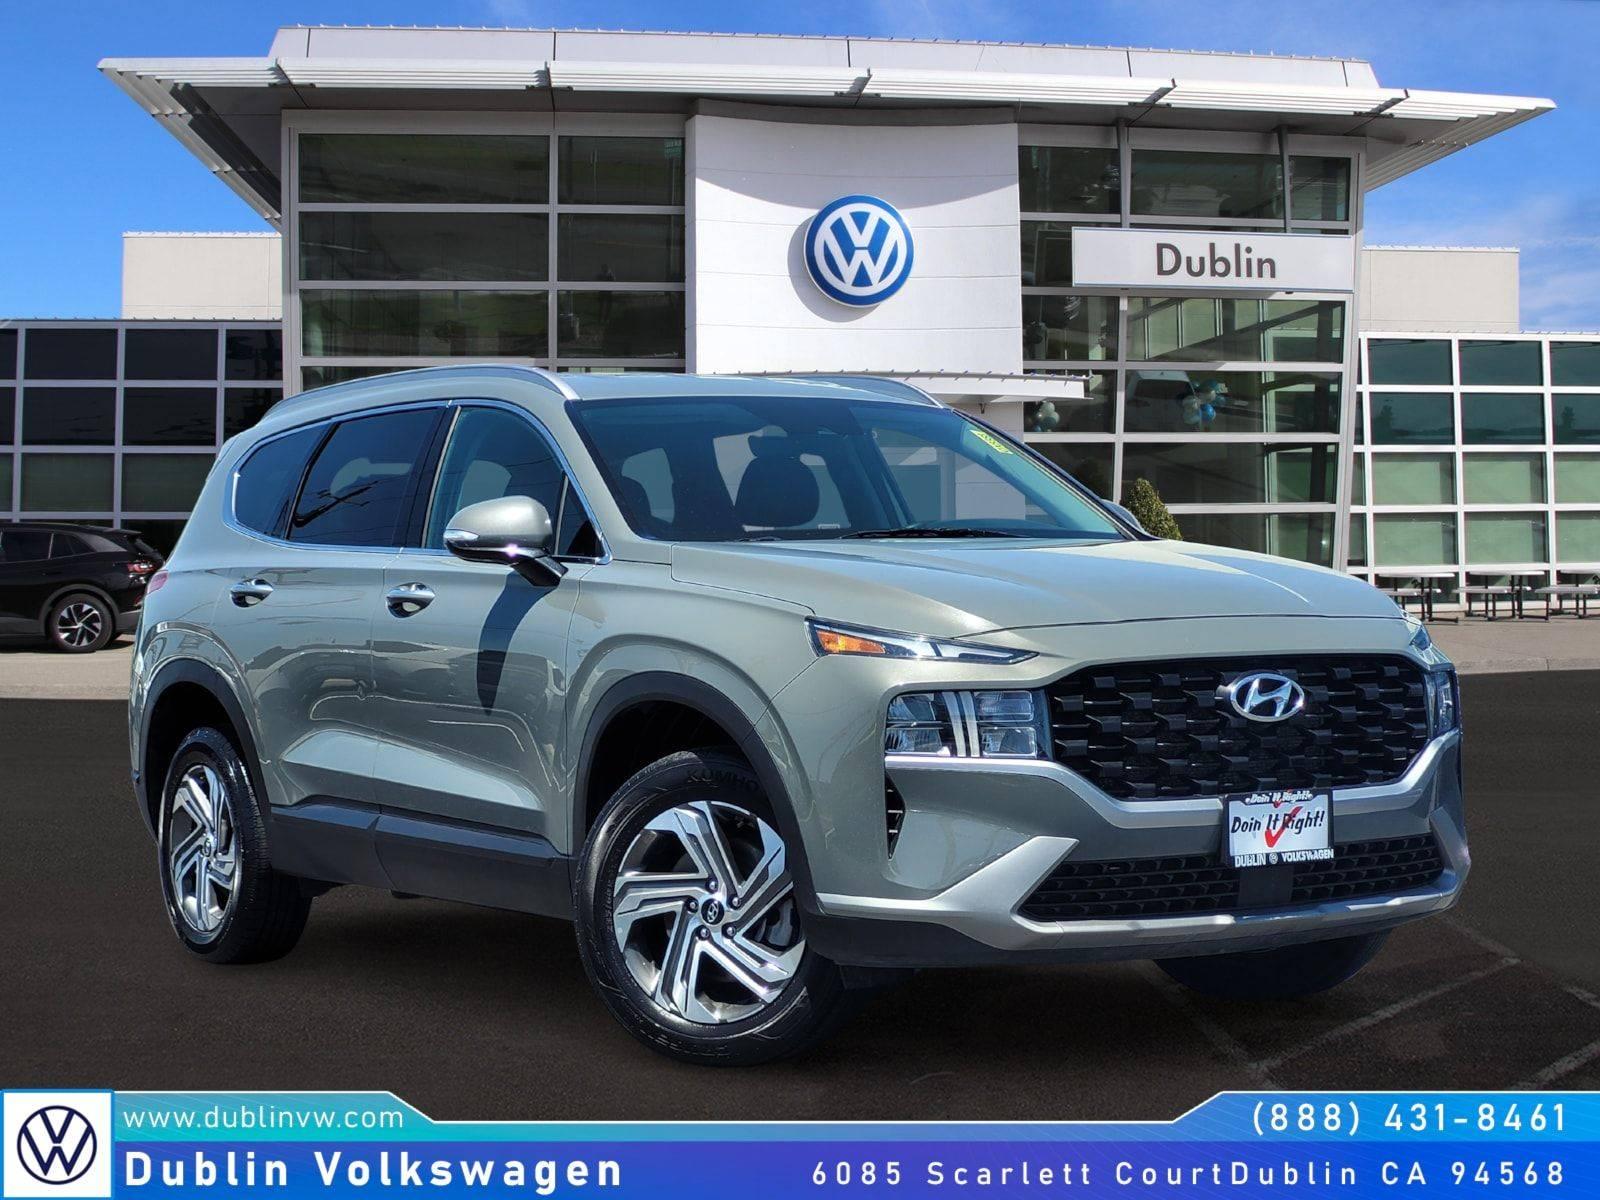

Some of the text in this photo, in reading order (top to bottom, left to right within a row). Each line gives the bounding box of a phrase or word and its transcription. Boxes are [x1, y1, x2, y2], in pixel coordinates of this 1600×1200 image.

[1156, 242, 1276, 278] Dublin
[1231, 810, 1325, 835] Doin' It Right!
[1234, 853, 1267, 868] DUBLIN
[1281, 848, 1335, 863] VOLKSWAGEN
